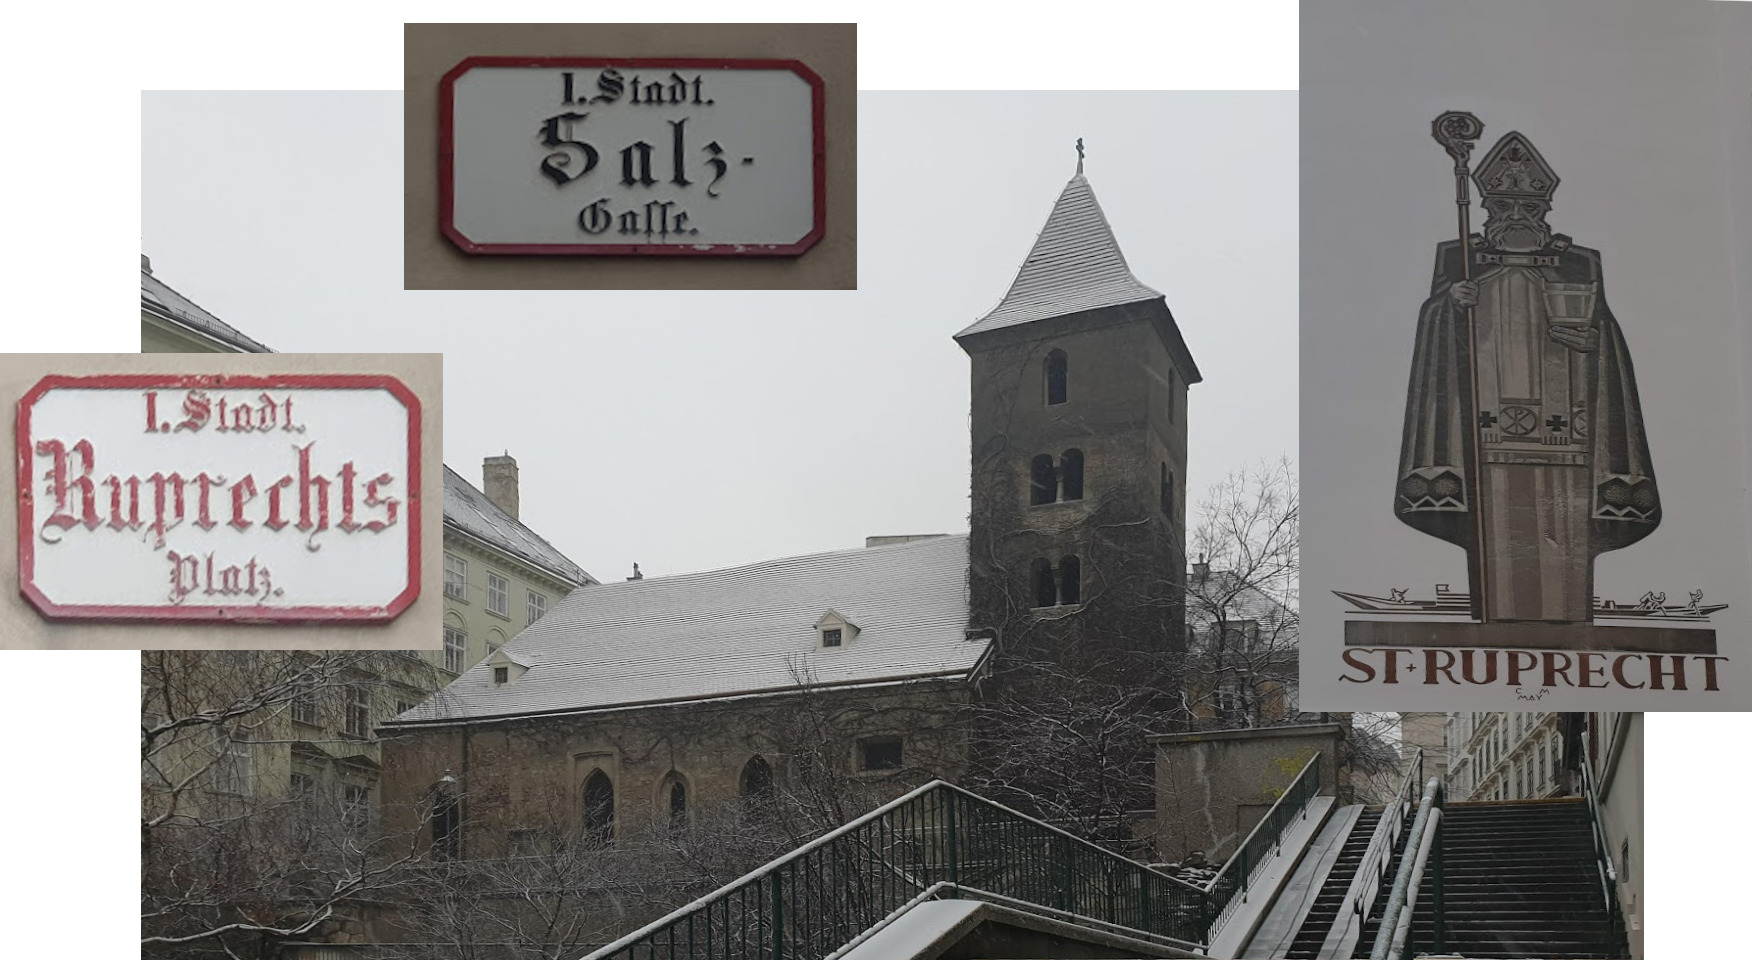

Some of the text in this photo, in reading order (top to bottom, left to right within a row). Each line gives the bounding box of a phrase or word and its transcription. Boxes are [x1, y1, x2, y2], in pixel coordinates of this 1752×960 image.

[538, 111, 755, 199] Salz-
[36, 439, 401, 552] Ruprechts
[167, 550, 285, 604] Platz.
